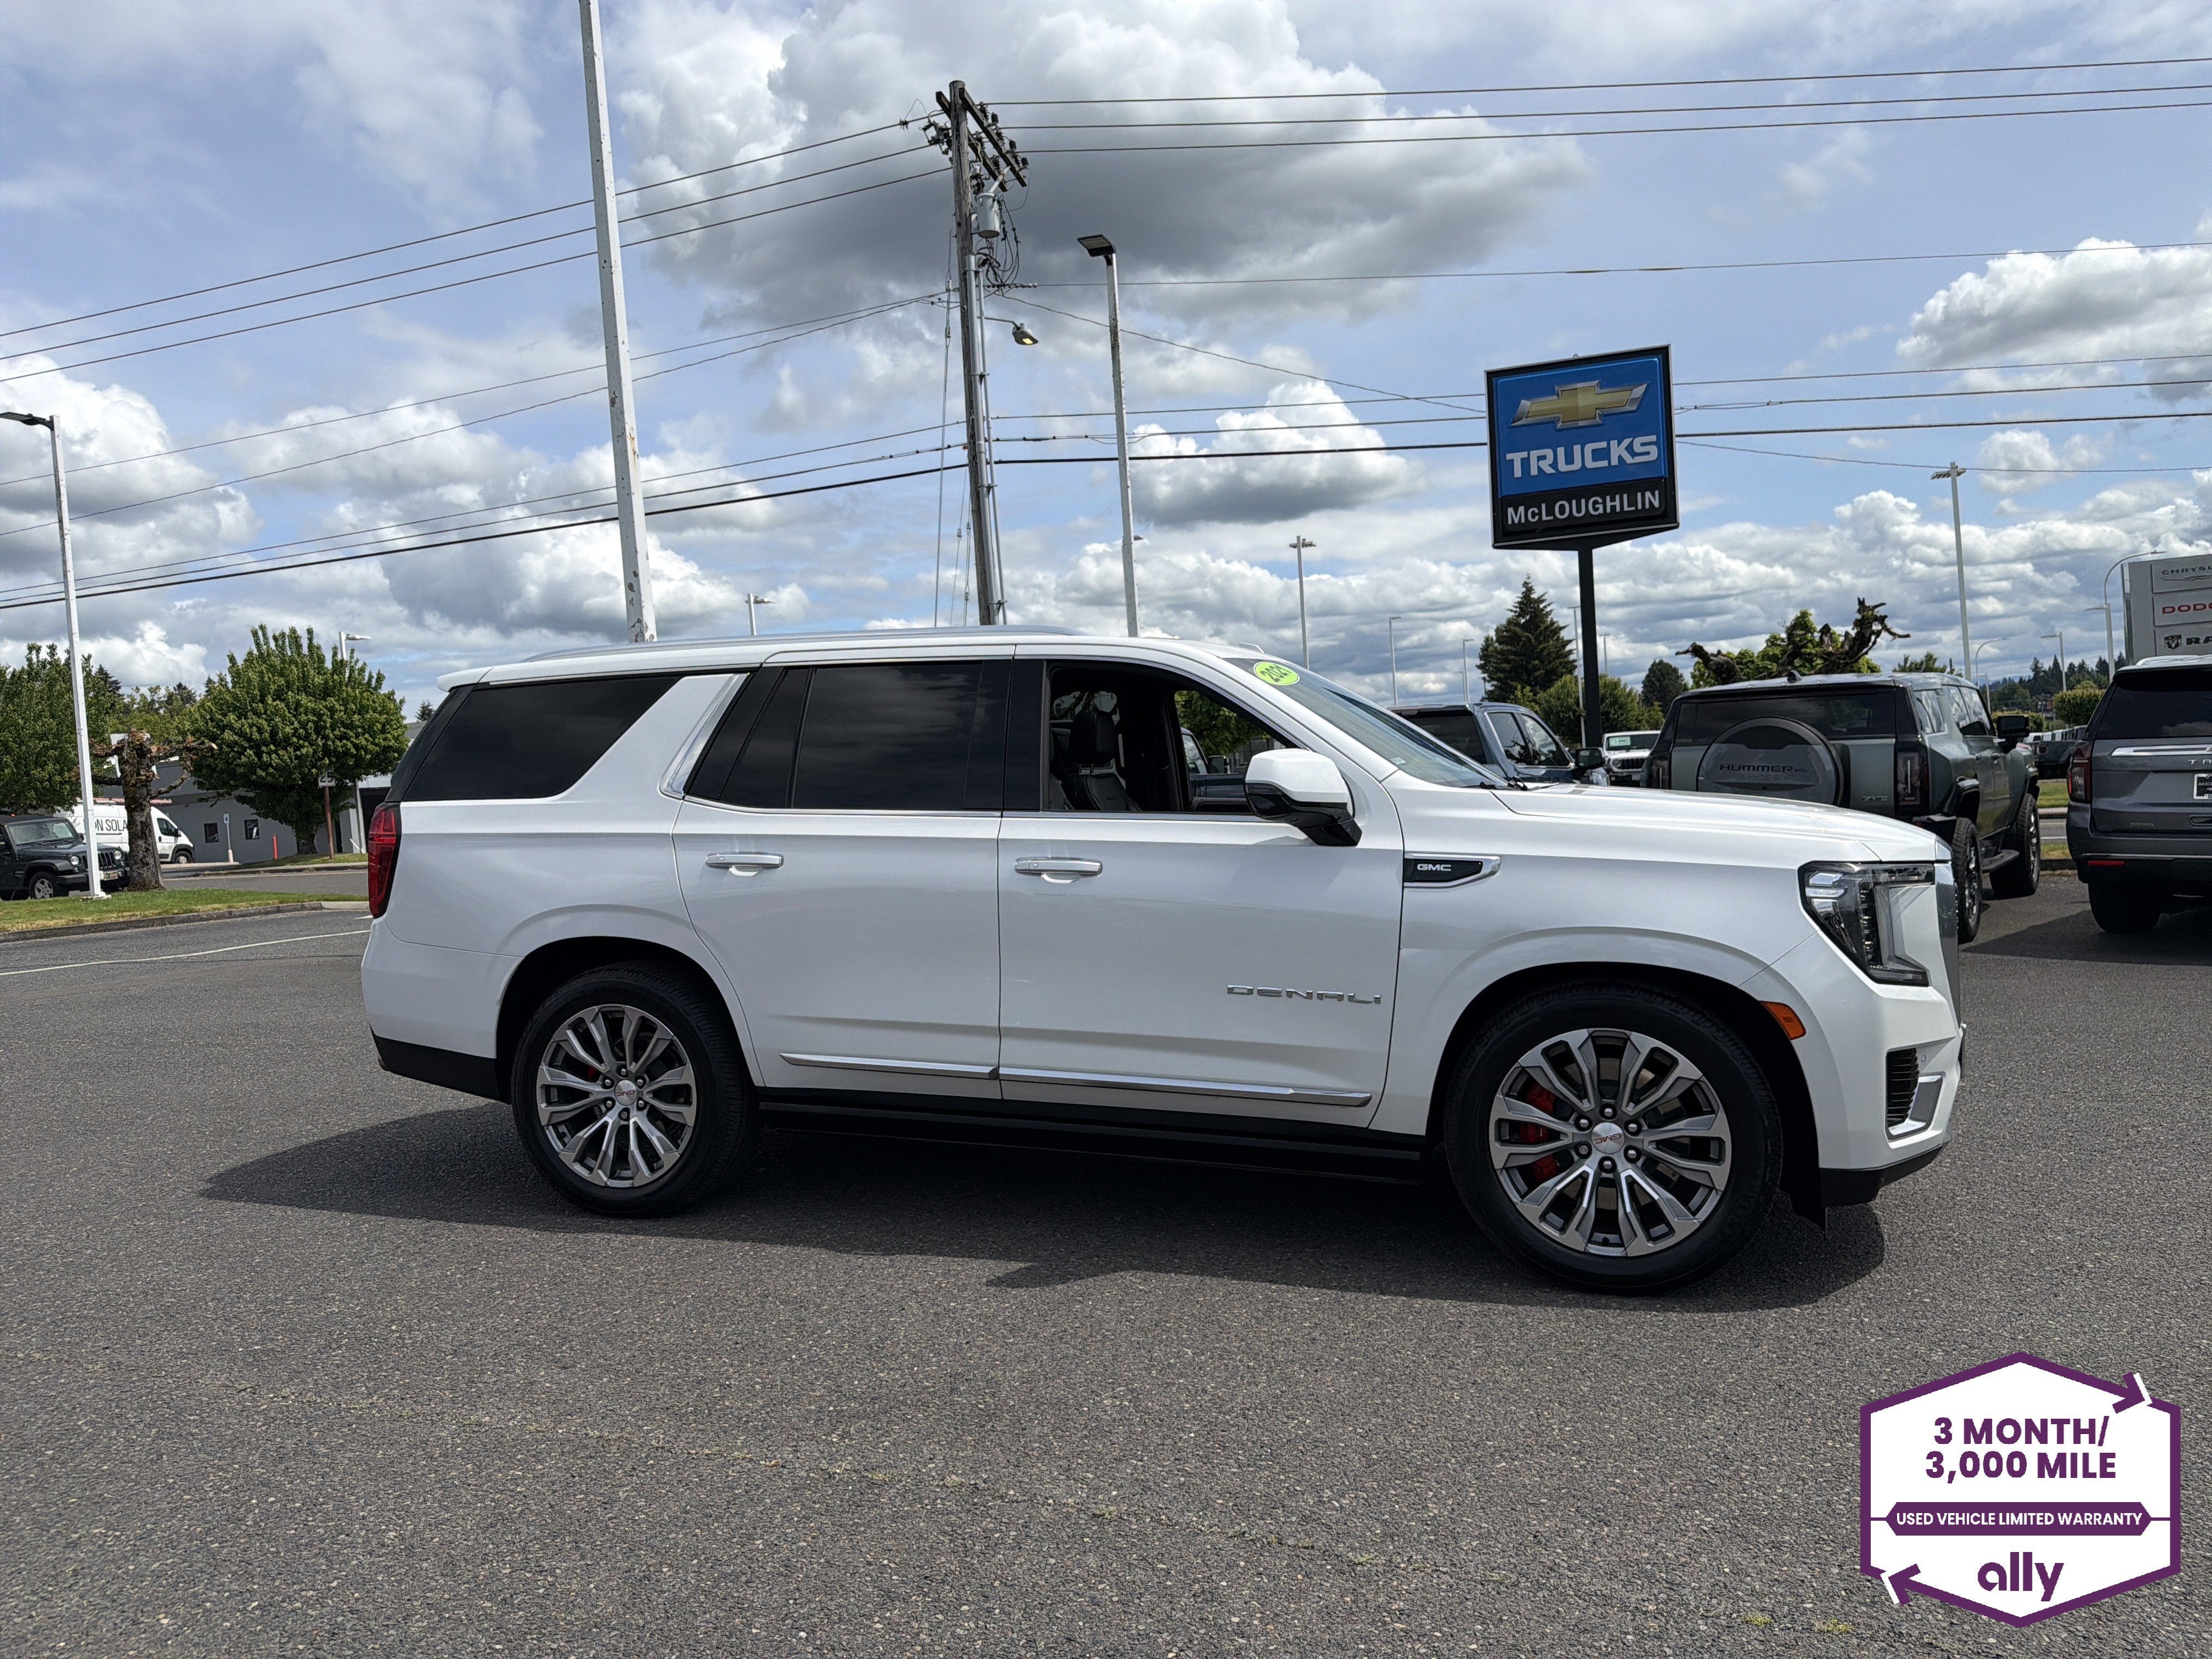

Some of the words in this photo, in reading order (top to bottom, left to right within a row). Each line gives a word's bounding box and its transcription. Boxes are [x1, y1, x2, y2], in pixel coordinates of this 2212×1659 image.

[1506, 435, 1657, 478] TRUCKS
[1507, 490, 1660, 524] McLOUGHLIN
[1260, 664, 1293, 682] 2021
[1719, 764, 1793, 772] HUMMER
[1227, 984, 1381, 1005] DENALI
[1594, 1133, 1622, 1144] GMC
